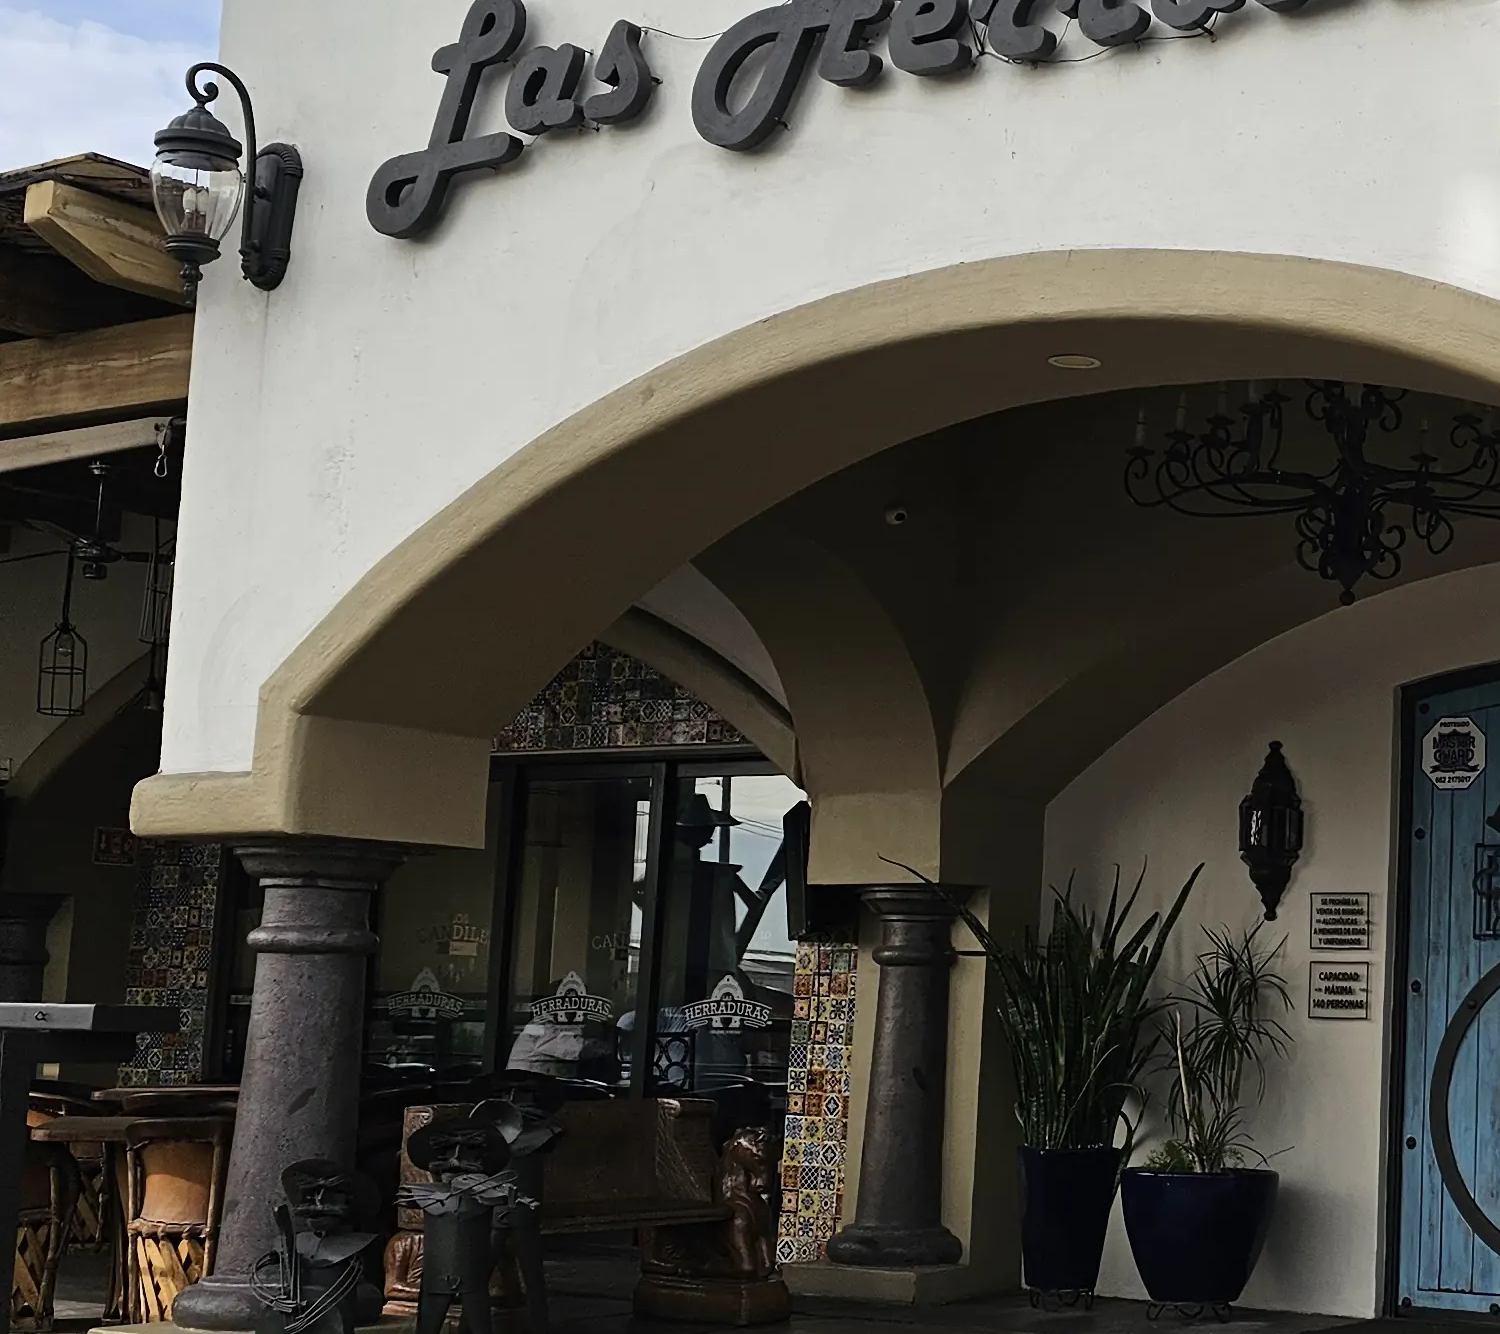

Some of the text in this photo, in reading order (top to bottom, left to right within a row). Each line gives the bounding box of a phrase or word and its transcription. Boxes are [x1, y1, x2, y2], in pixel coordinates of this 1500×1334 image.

[1433, 748, 1474, 764] GUARD
[1319, 971, 1360, 981] CAPACIDAD
[387, 992, 464, 1014] HERRADURAS
[531, 997, 611, 1017] HERRADURAS
[684, 1001, 770, 1022] HERRADURAS
[1326, 999, 1364, 1009] PERSONAS
